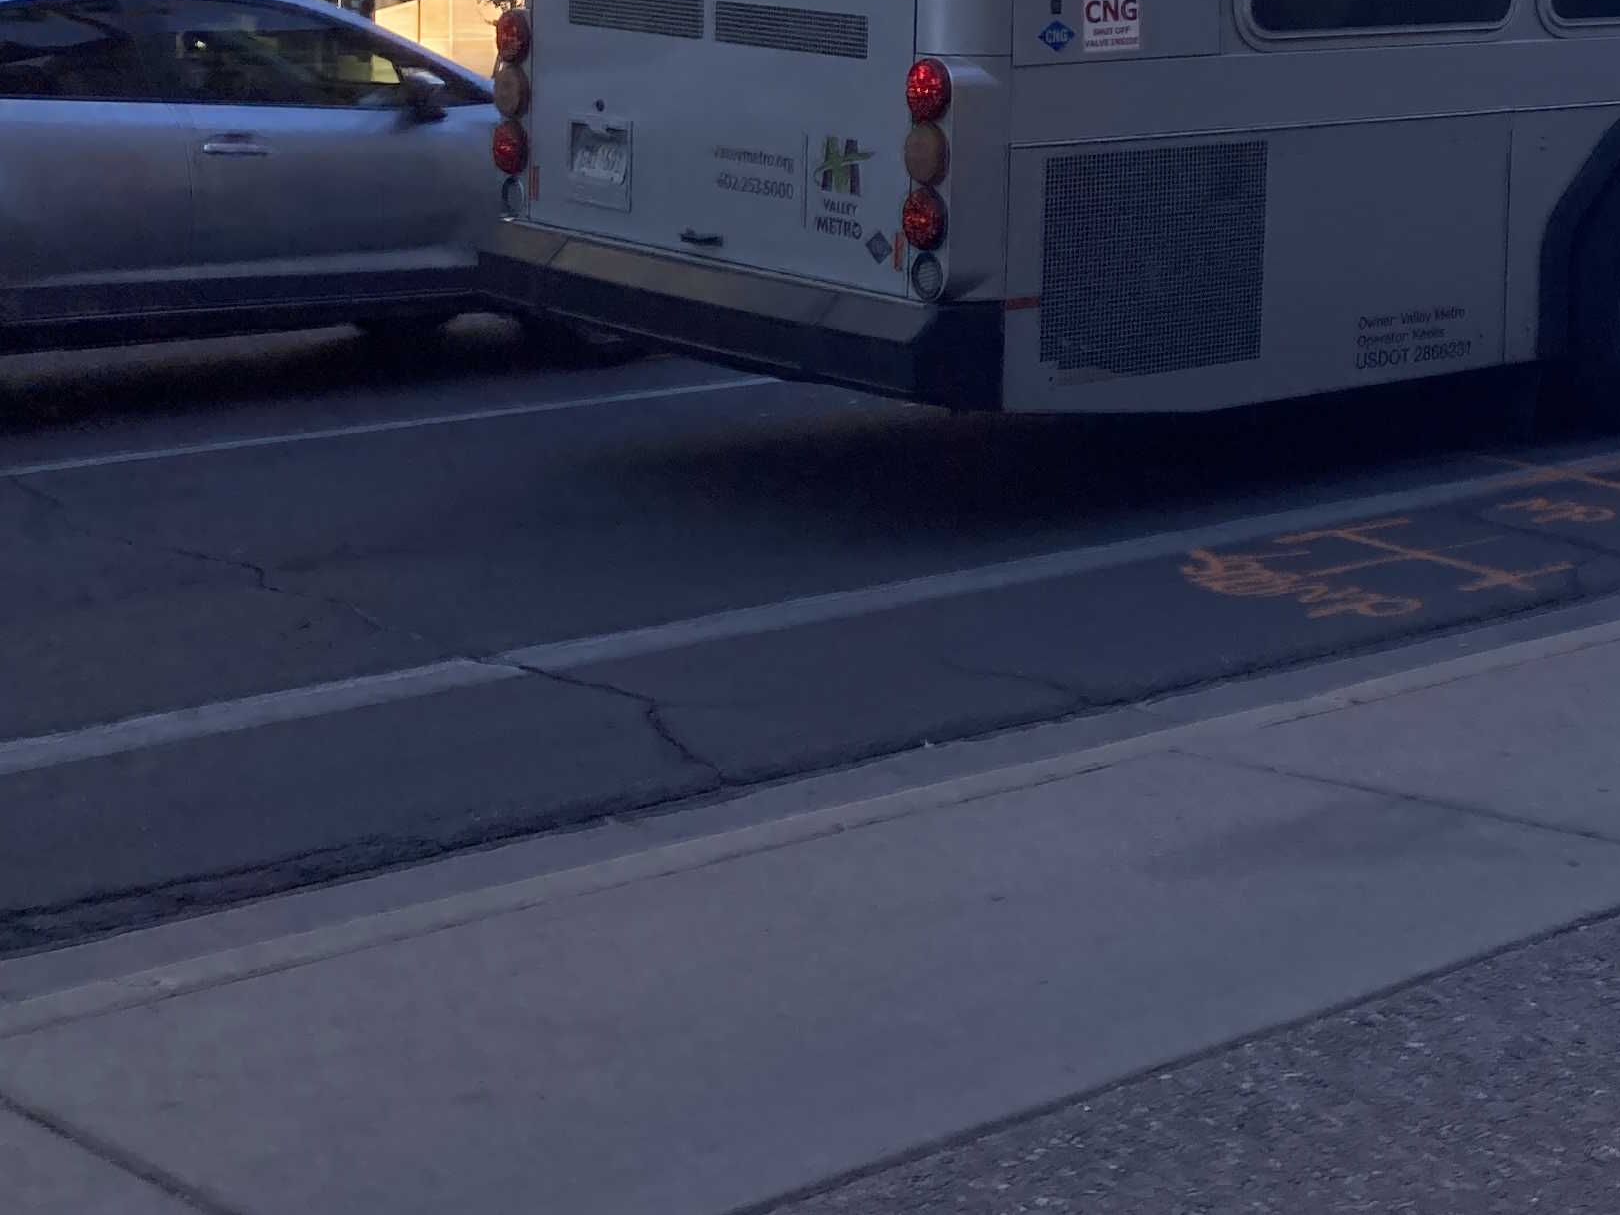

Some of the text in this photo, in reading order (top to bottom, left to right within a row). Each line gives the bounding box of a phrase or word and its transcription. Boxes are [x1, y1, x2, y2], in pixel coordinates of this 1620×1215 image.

[1044, 30, 1071, 43] CNG
[1115, 25, 1130, 34] OFF
[823, 197, 858, 216] VALLEY
[815, 217, 863, 240] METRO
[1356, 347, 1410, 369] USDOT
